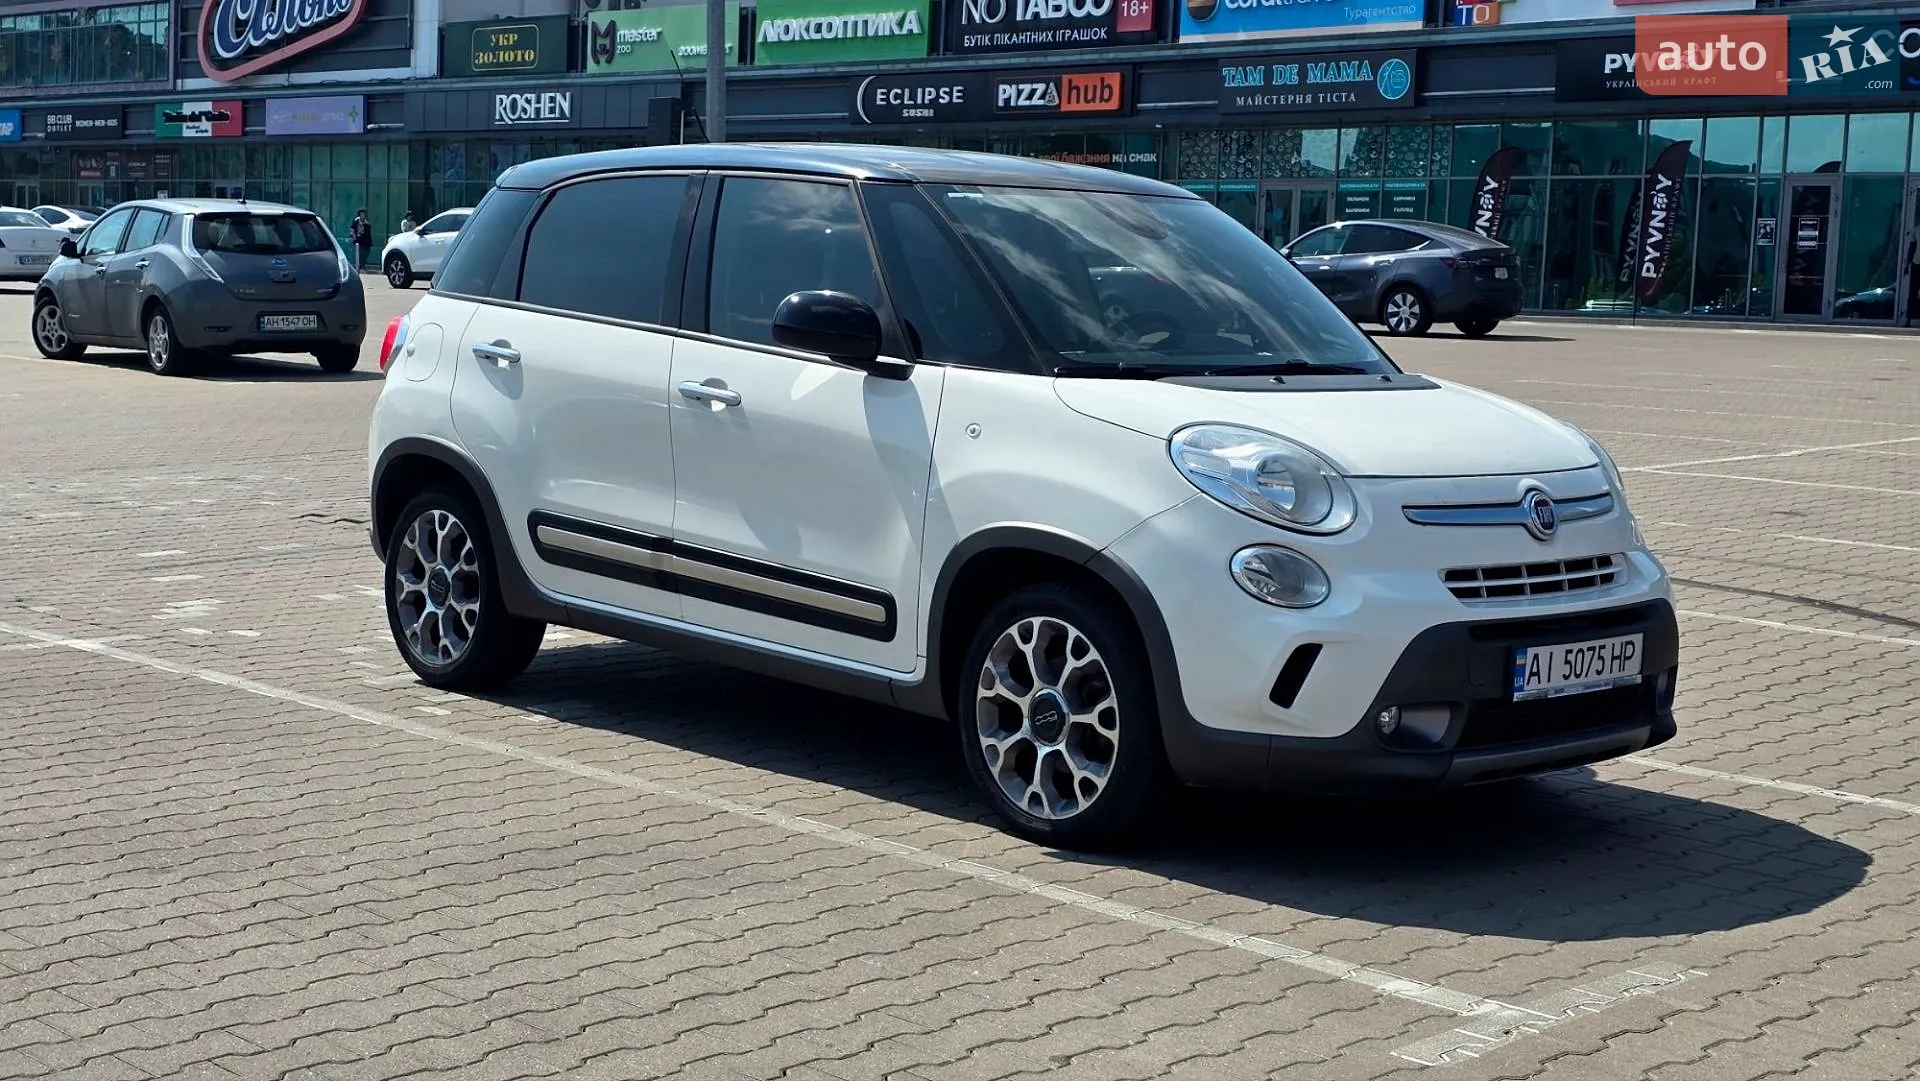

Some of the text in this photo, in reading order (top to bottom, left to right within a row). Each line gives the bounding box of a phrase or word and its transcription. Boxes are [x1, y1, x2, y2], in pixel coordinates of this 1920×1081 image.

[1121, 0, 1149, 17] 18+
[1344, 5, 1415, 18] Турагентство
[616, 26, 662, 43] master
[757, 10, 922, 43] ЛЮКСОПТИКА
[490, 33, 518, 47] УКР
[964, 27, 1107, 47] БУТІК ПІКАНТНИХ ІГРАШОК
[475, 49, 535, 65] ЗОЛОТО
[1222, 65, 1264, 88] TAM
[1272, 63, 1299, 86] DE
[1307, 60, 1373, 84] MAMA
[875, 86, 965, 106] ECLIPSE
[998, 78, 1113, 107] PIZZA hub
[1236, 92, 1356, 107] МАЙСТЕРНЯ ТІСТА
[494, 92, 571, 123] ROSHEN
[1129, 153, 1158, 163] смак
[265, 315, 316, 327] AH 1547 OH
[1526, 640, 1636, 686] AI 5075 HP
